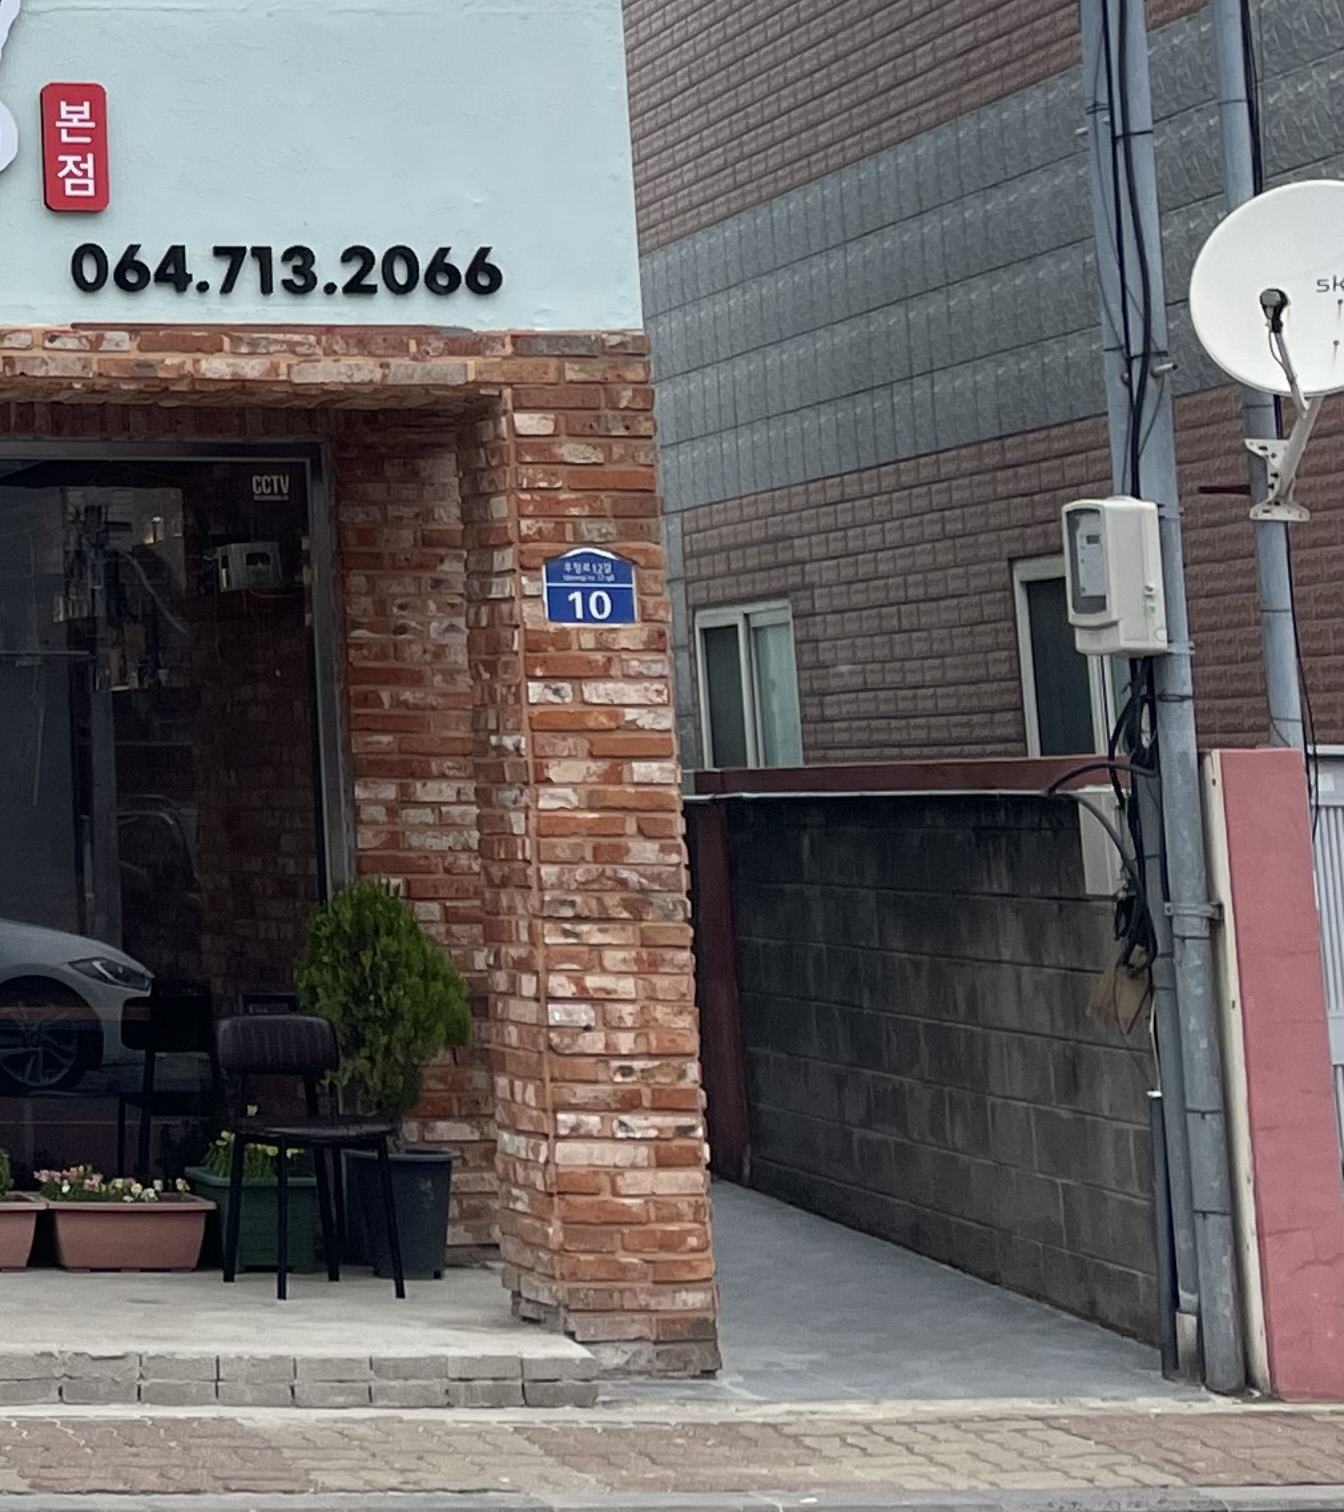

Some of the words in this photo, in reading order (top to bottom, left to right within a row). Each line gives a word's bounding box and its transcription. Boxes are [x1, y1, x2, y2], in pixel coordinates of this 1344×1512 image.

[70, 242, 504, 297] 064.713.2066
[252, 474, 290, 494] CCTV
[567, 590, 612, 620] 10
